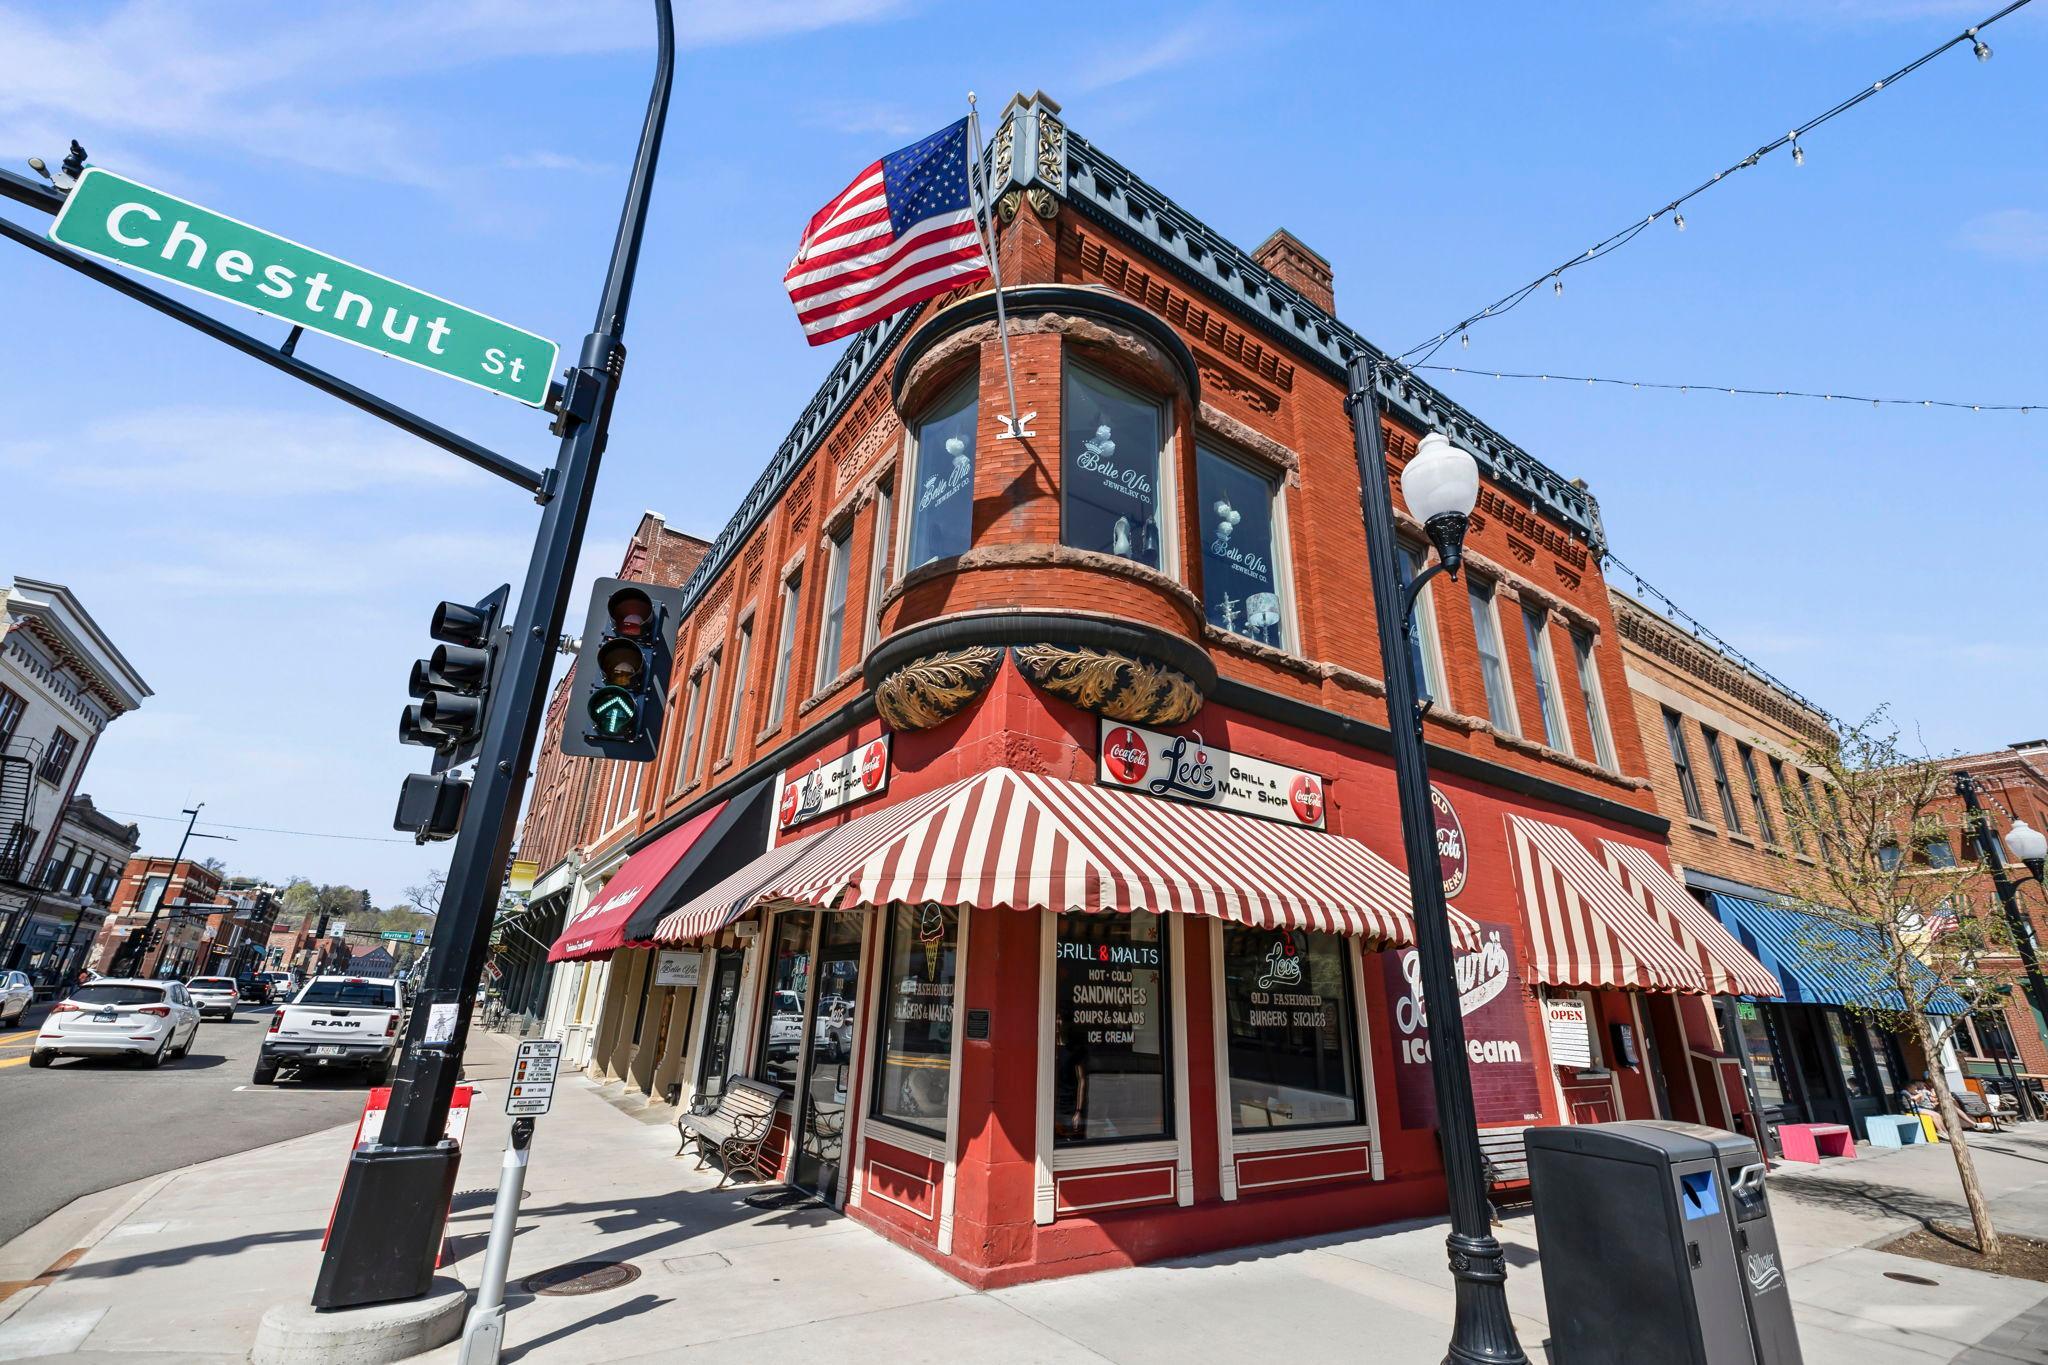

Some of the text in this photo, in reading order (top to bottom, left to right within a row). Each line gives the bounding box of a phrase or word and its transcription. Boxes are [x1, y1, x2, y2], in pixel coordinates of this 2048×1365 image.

[105, 202, 526, 383] Chestnut St
[1077, 450, 1152, 493] Belle Via
[918, 478, 947, 512] Belle
[1103, 479, 1139, 499] JEWELRY
[1211, 539, 1243, 562] Belle
[852, 765, 857, 773] &
[1229, 767, 1277, 790] GRILL &
[824, 777, 862, 799] MALT SHOP
[1218, 780, 1289, 807] MALT SHOP
[1431, 792, 1448, 815] OLD
[1099, 944, 1109, 961] &
[1111, 946, 1159, 964] MALTS
[1088, 969, 1133, 982] HOT COLD
[1073, 985, 1147, 1005] SANDWICHES
[1250, 992, 1322, 1006] OLD FASHIONED
[311, 1019, 361, 1028] RAM
[1073, 1010, 1145, 1025] SOUPS & SALADS
[1249, 1010, 1288, 1026] BURGERS
[1551, 1010, 1583, 1020] OPEN
[1087, 1031, 1135, 1043] ICE CREAM
[1465, 1038, 1522, 1064] eam
